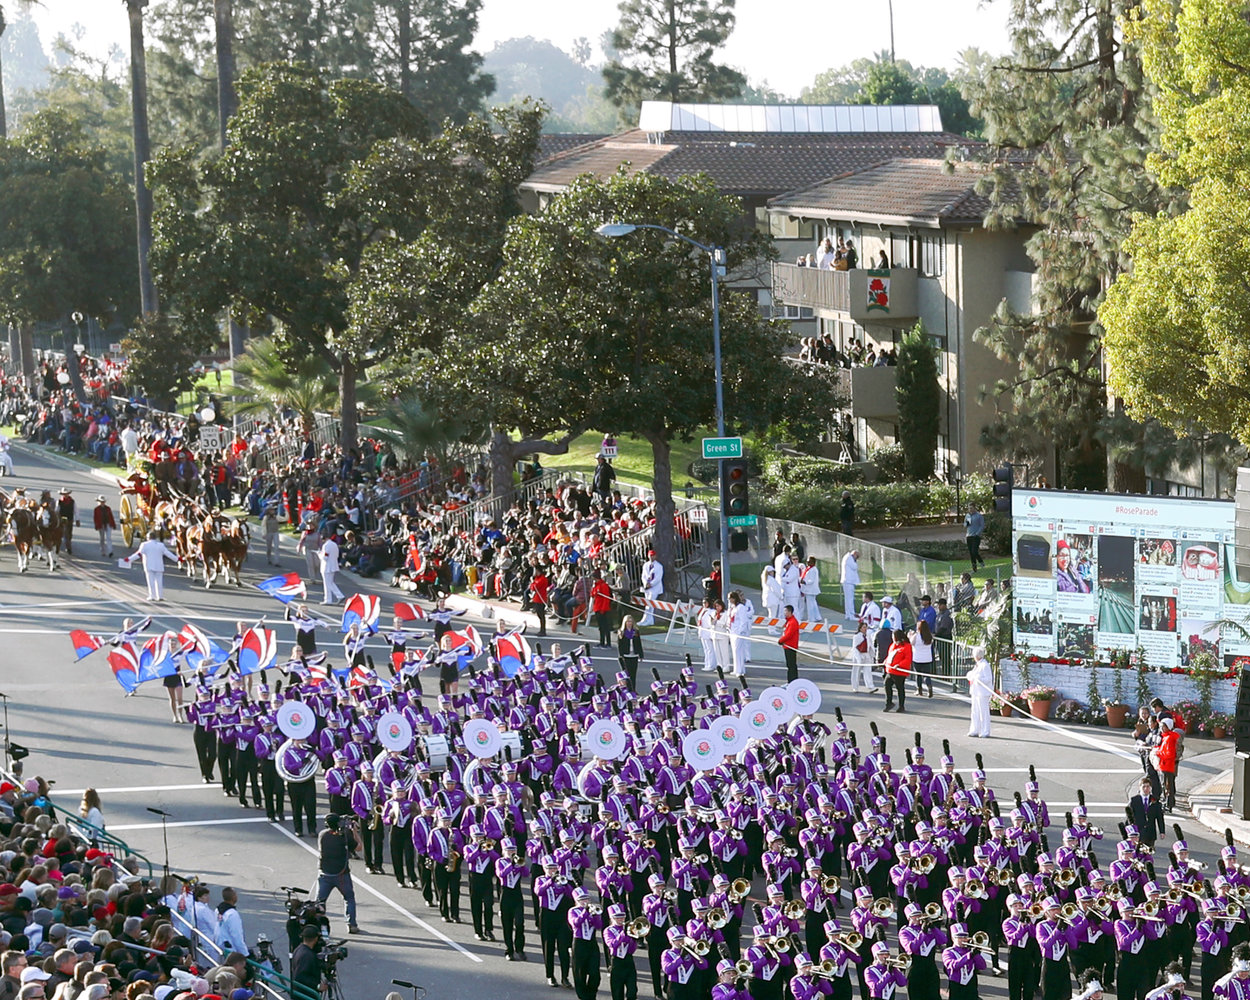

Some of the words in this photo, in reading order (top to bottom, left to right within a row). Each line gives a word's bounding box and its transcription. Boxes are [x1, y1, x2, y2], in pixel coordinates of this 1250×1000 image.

[203, 438, 218, 448] 30
[706, 444, 728, 453] Green
[729, 443, 738, 452] St
[1115, 506, 1158, 517] #RoseParade
[730, 517, 745, 526] Green
